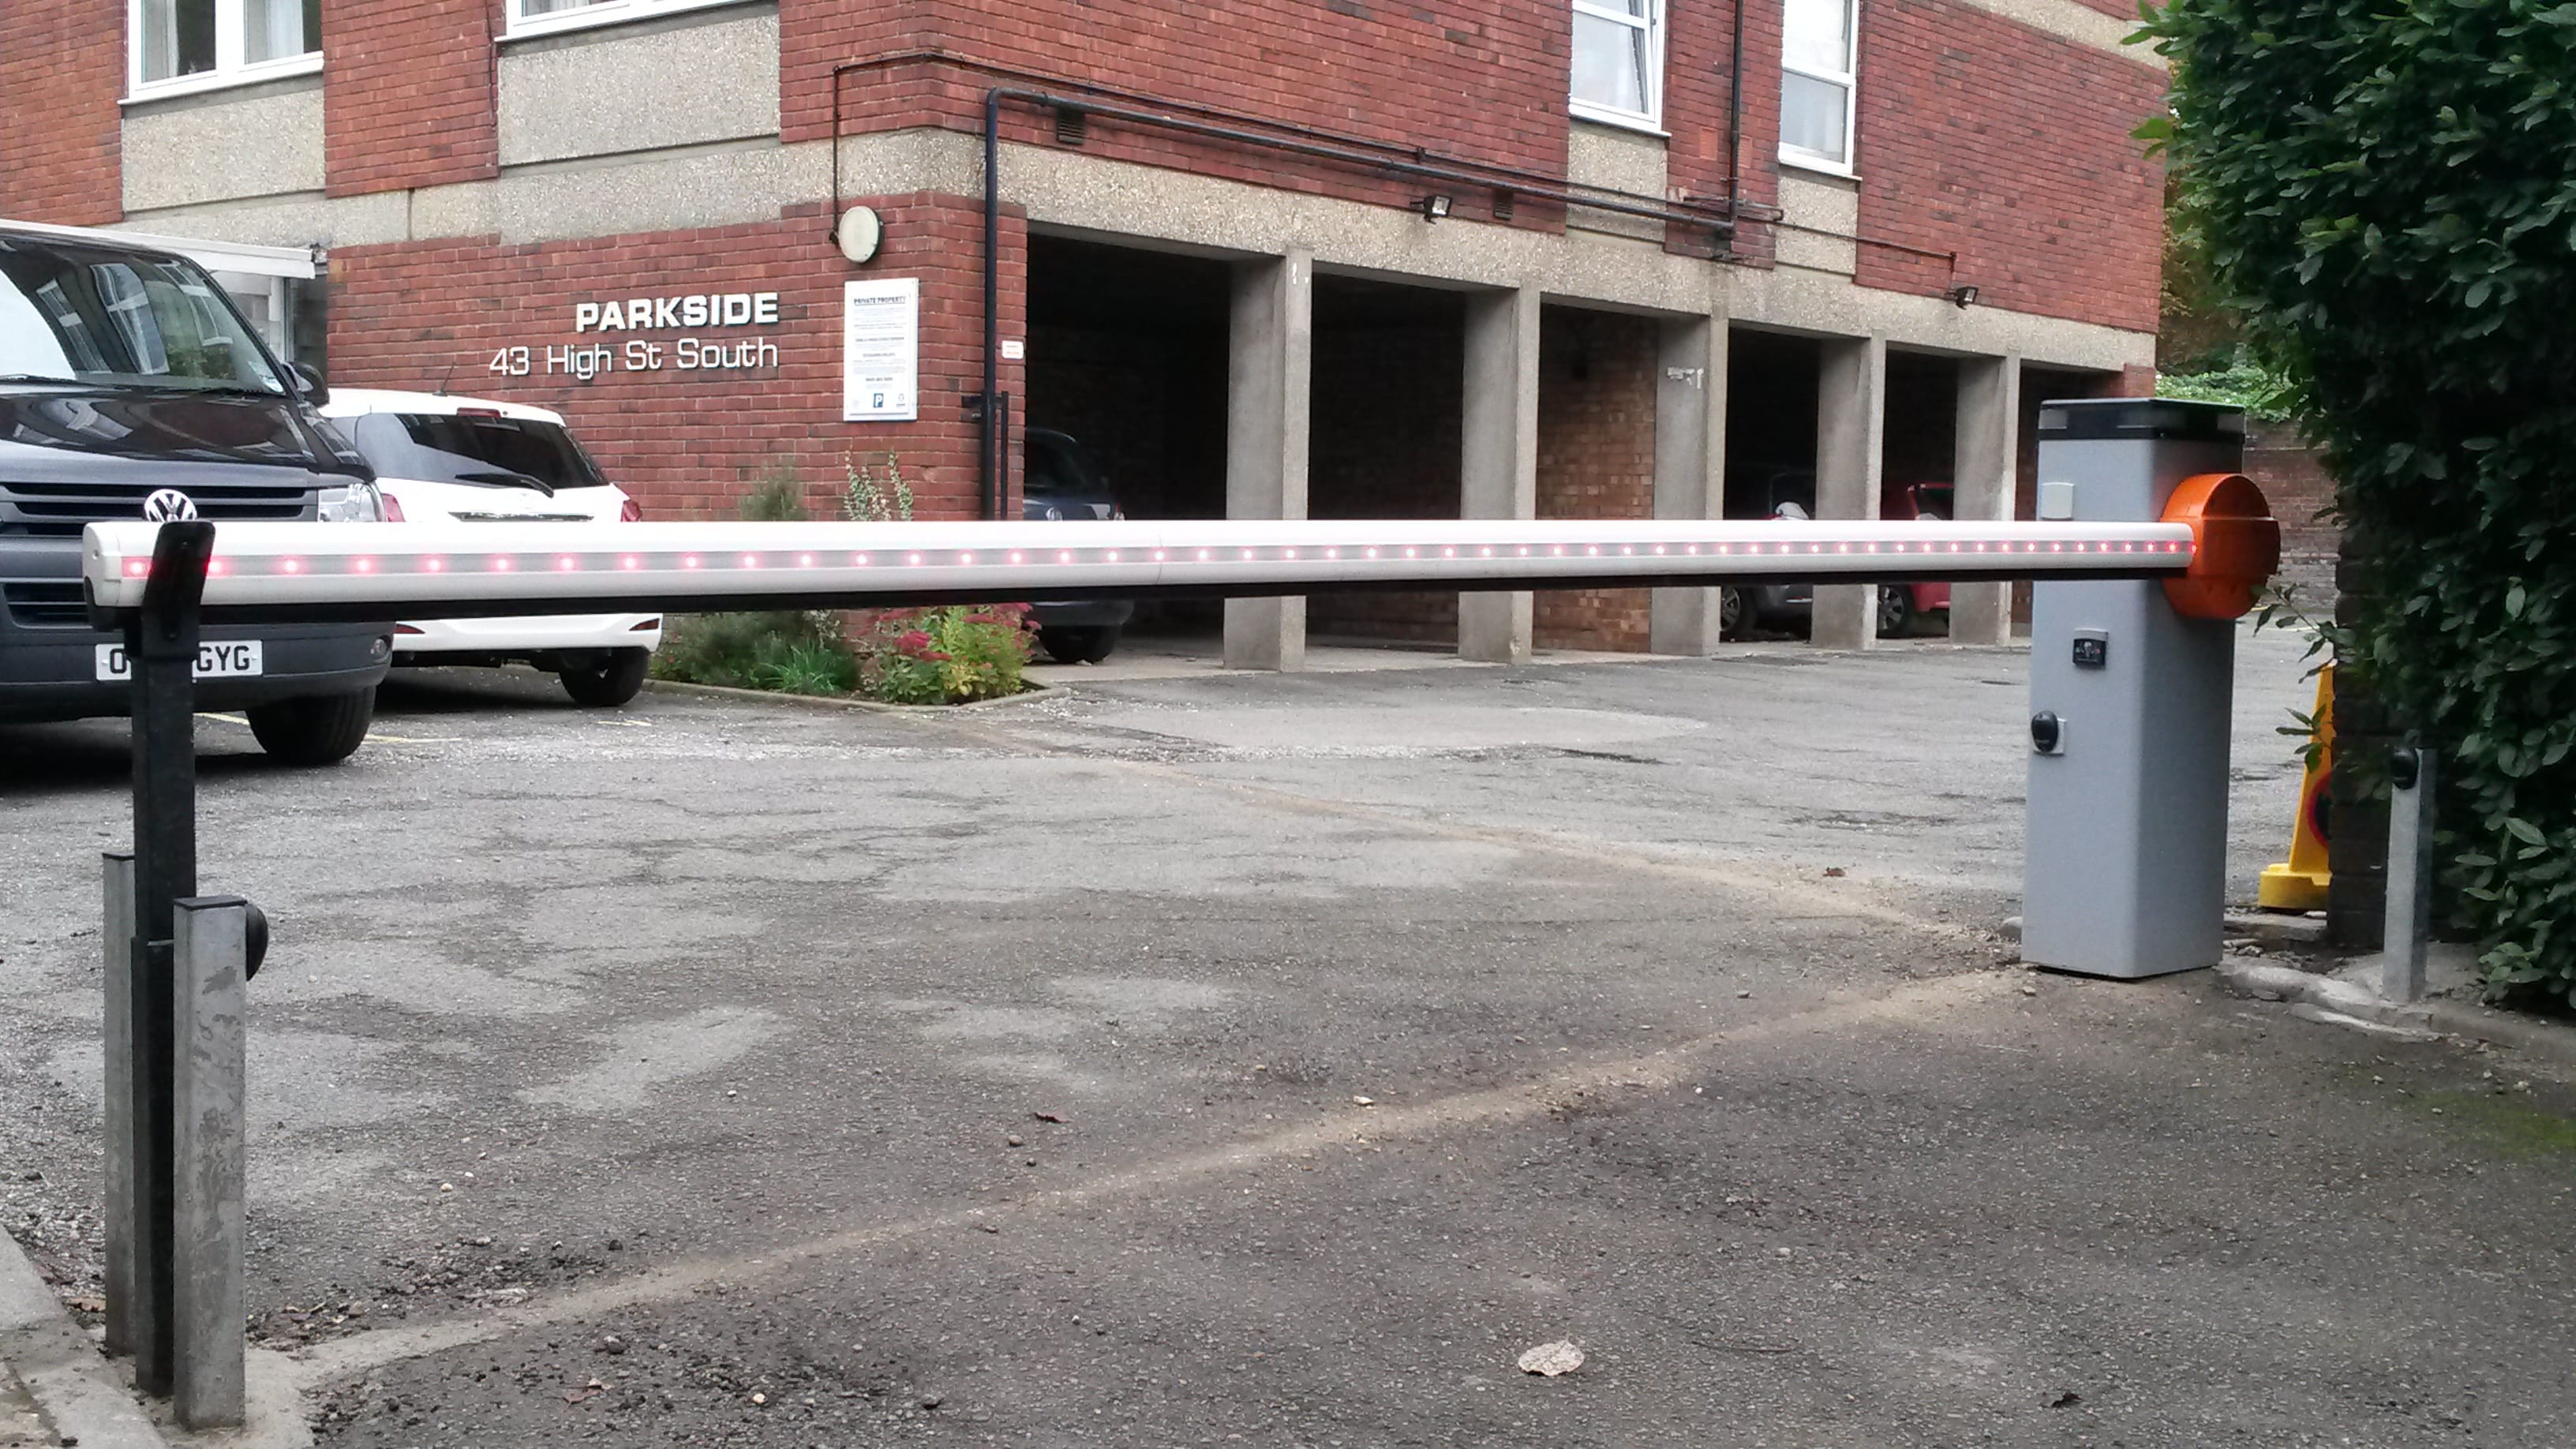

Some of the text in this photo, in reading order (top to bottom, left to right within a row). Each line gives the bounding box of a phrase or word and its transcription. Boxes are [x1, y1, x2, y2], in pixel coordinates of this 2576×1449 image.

[576, 293, 778, 332] PARKSIDE
[489, 336, 778, 380] 43 High St South
[197, 645, 250, 672] GYG
